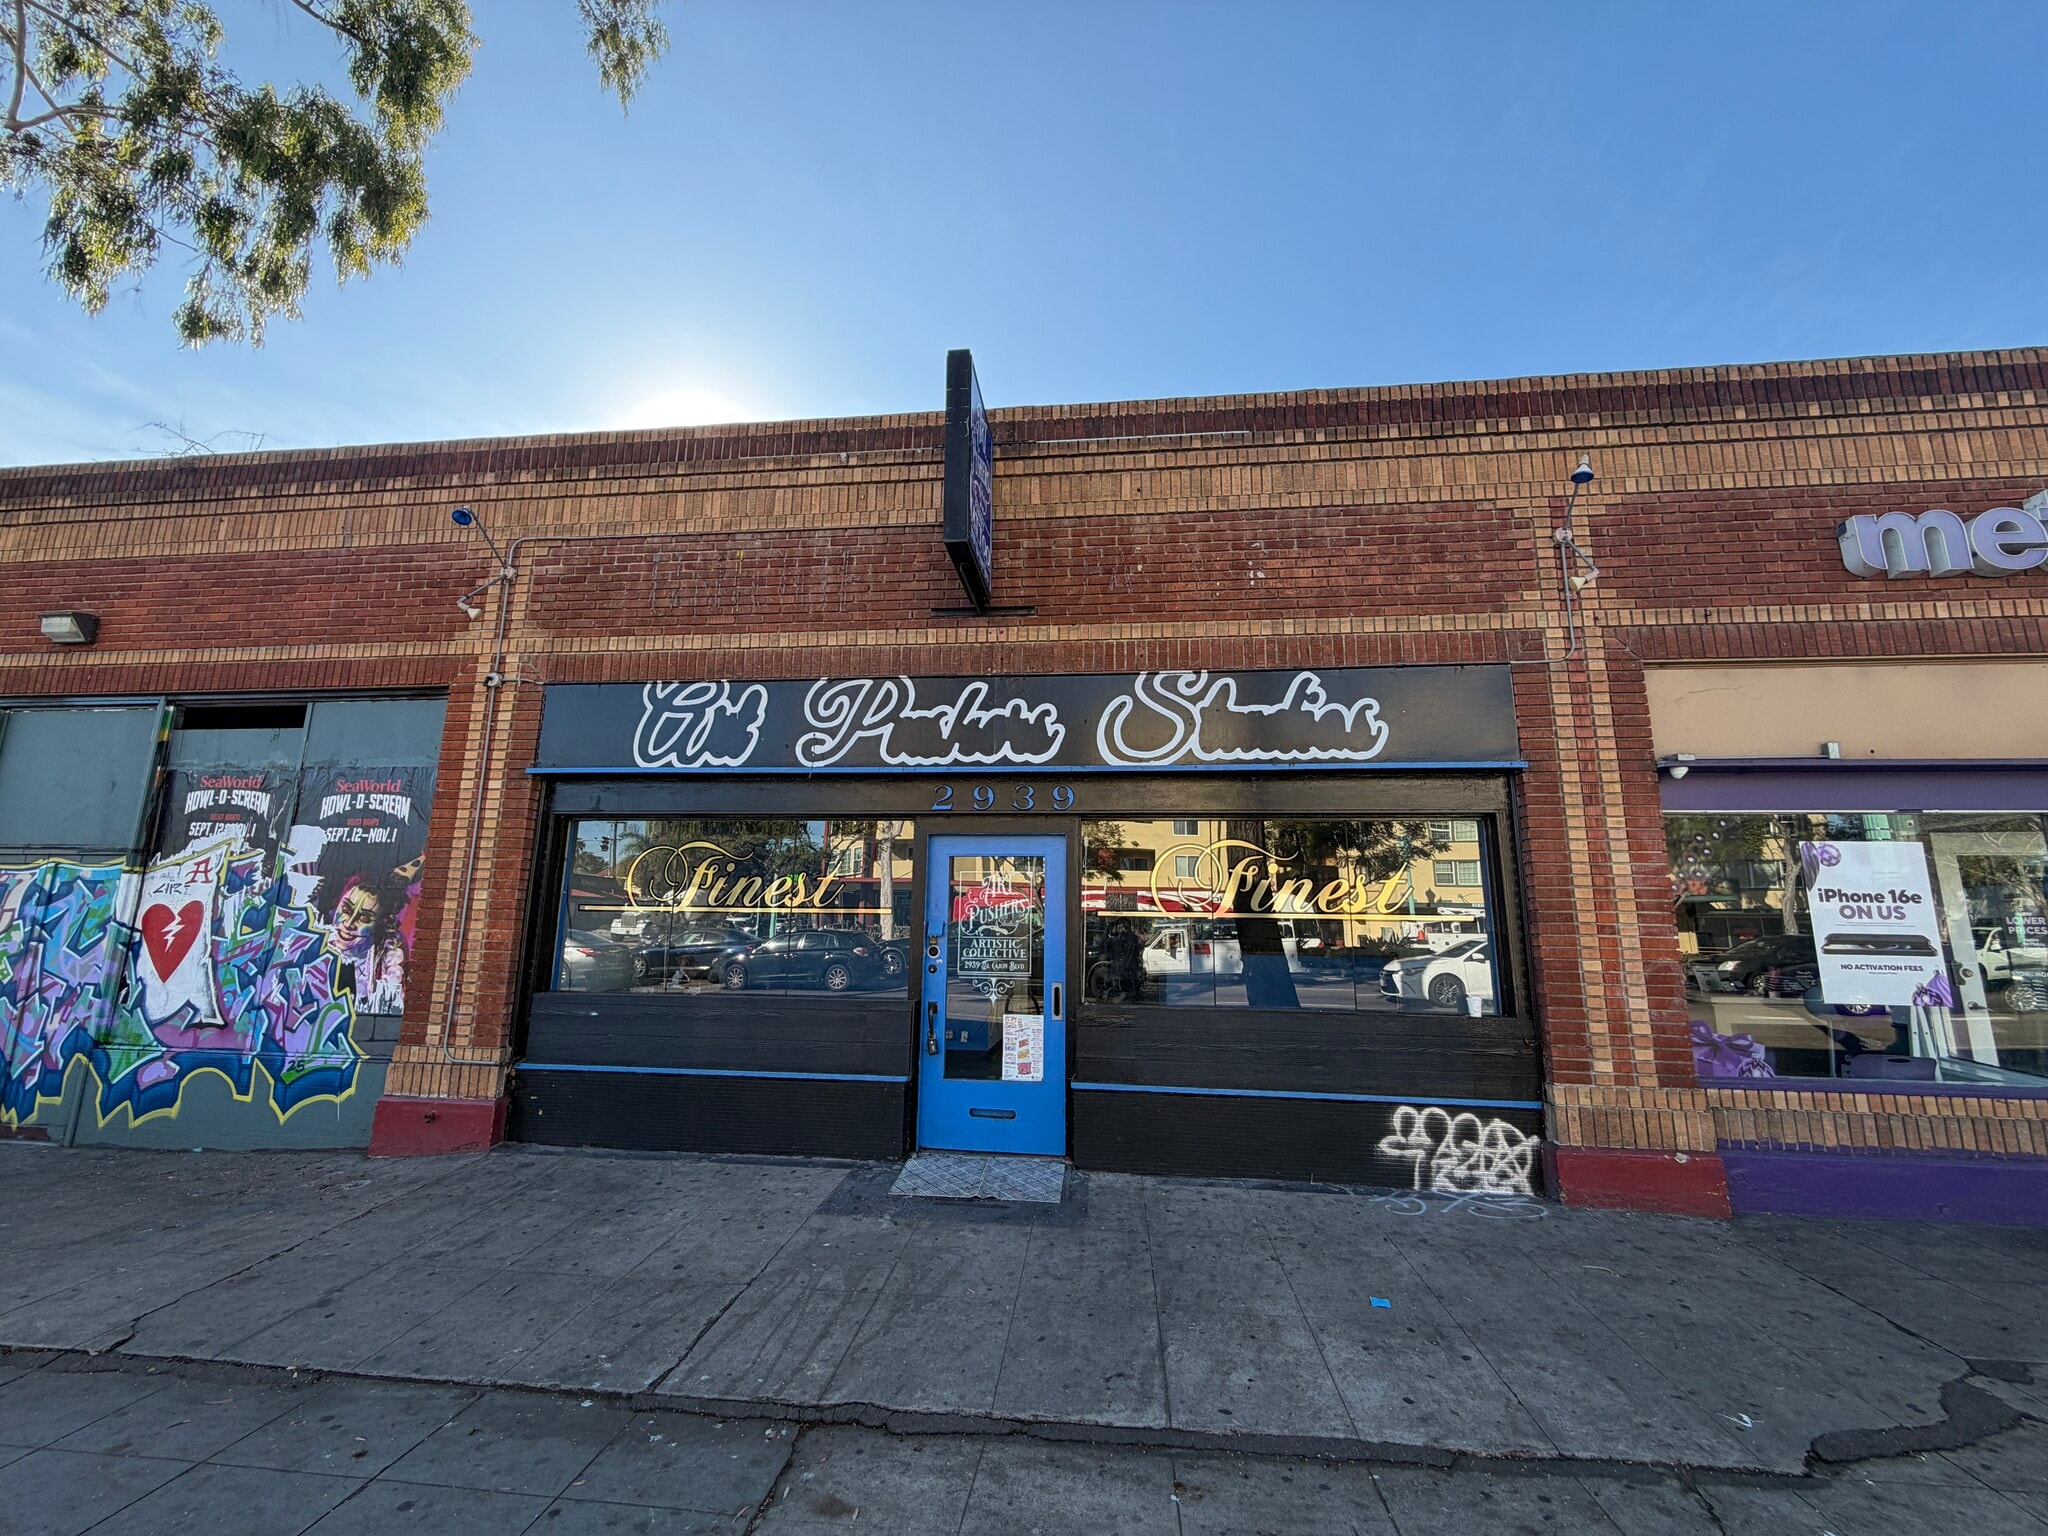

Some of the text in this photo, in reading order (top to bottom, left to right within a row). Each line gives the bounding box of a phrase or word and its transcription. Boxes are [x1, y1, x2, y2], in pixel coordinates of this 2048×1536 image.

[200, 775, 262, 789] SeaWorld
[336, 780, 401, 793] SeaWorld
[184, 789, 271, 820] HOWL-O-SCREAM
[931, 785, 1075, 811] 2939
[319, 794, 411, 825] HOWL-O-SCREAM
[627, 841, 846, 914] Finest
[1150, 839, 1415, 918] Finest
[1817, 888, 1922, 904] iPhone 16e
[1839, 905, 1907, 920] ON US
[970, 939, 1022, 949] ARTISTIC
[963, 948, 1027, 958] COLLECTIVE
[964, 961, 980, 969] 2939
